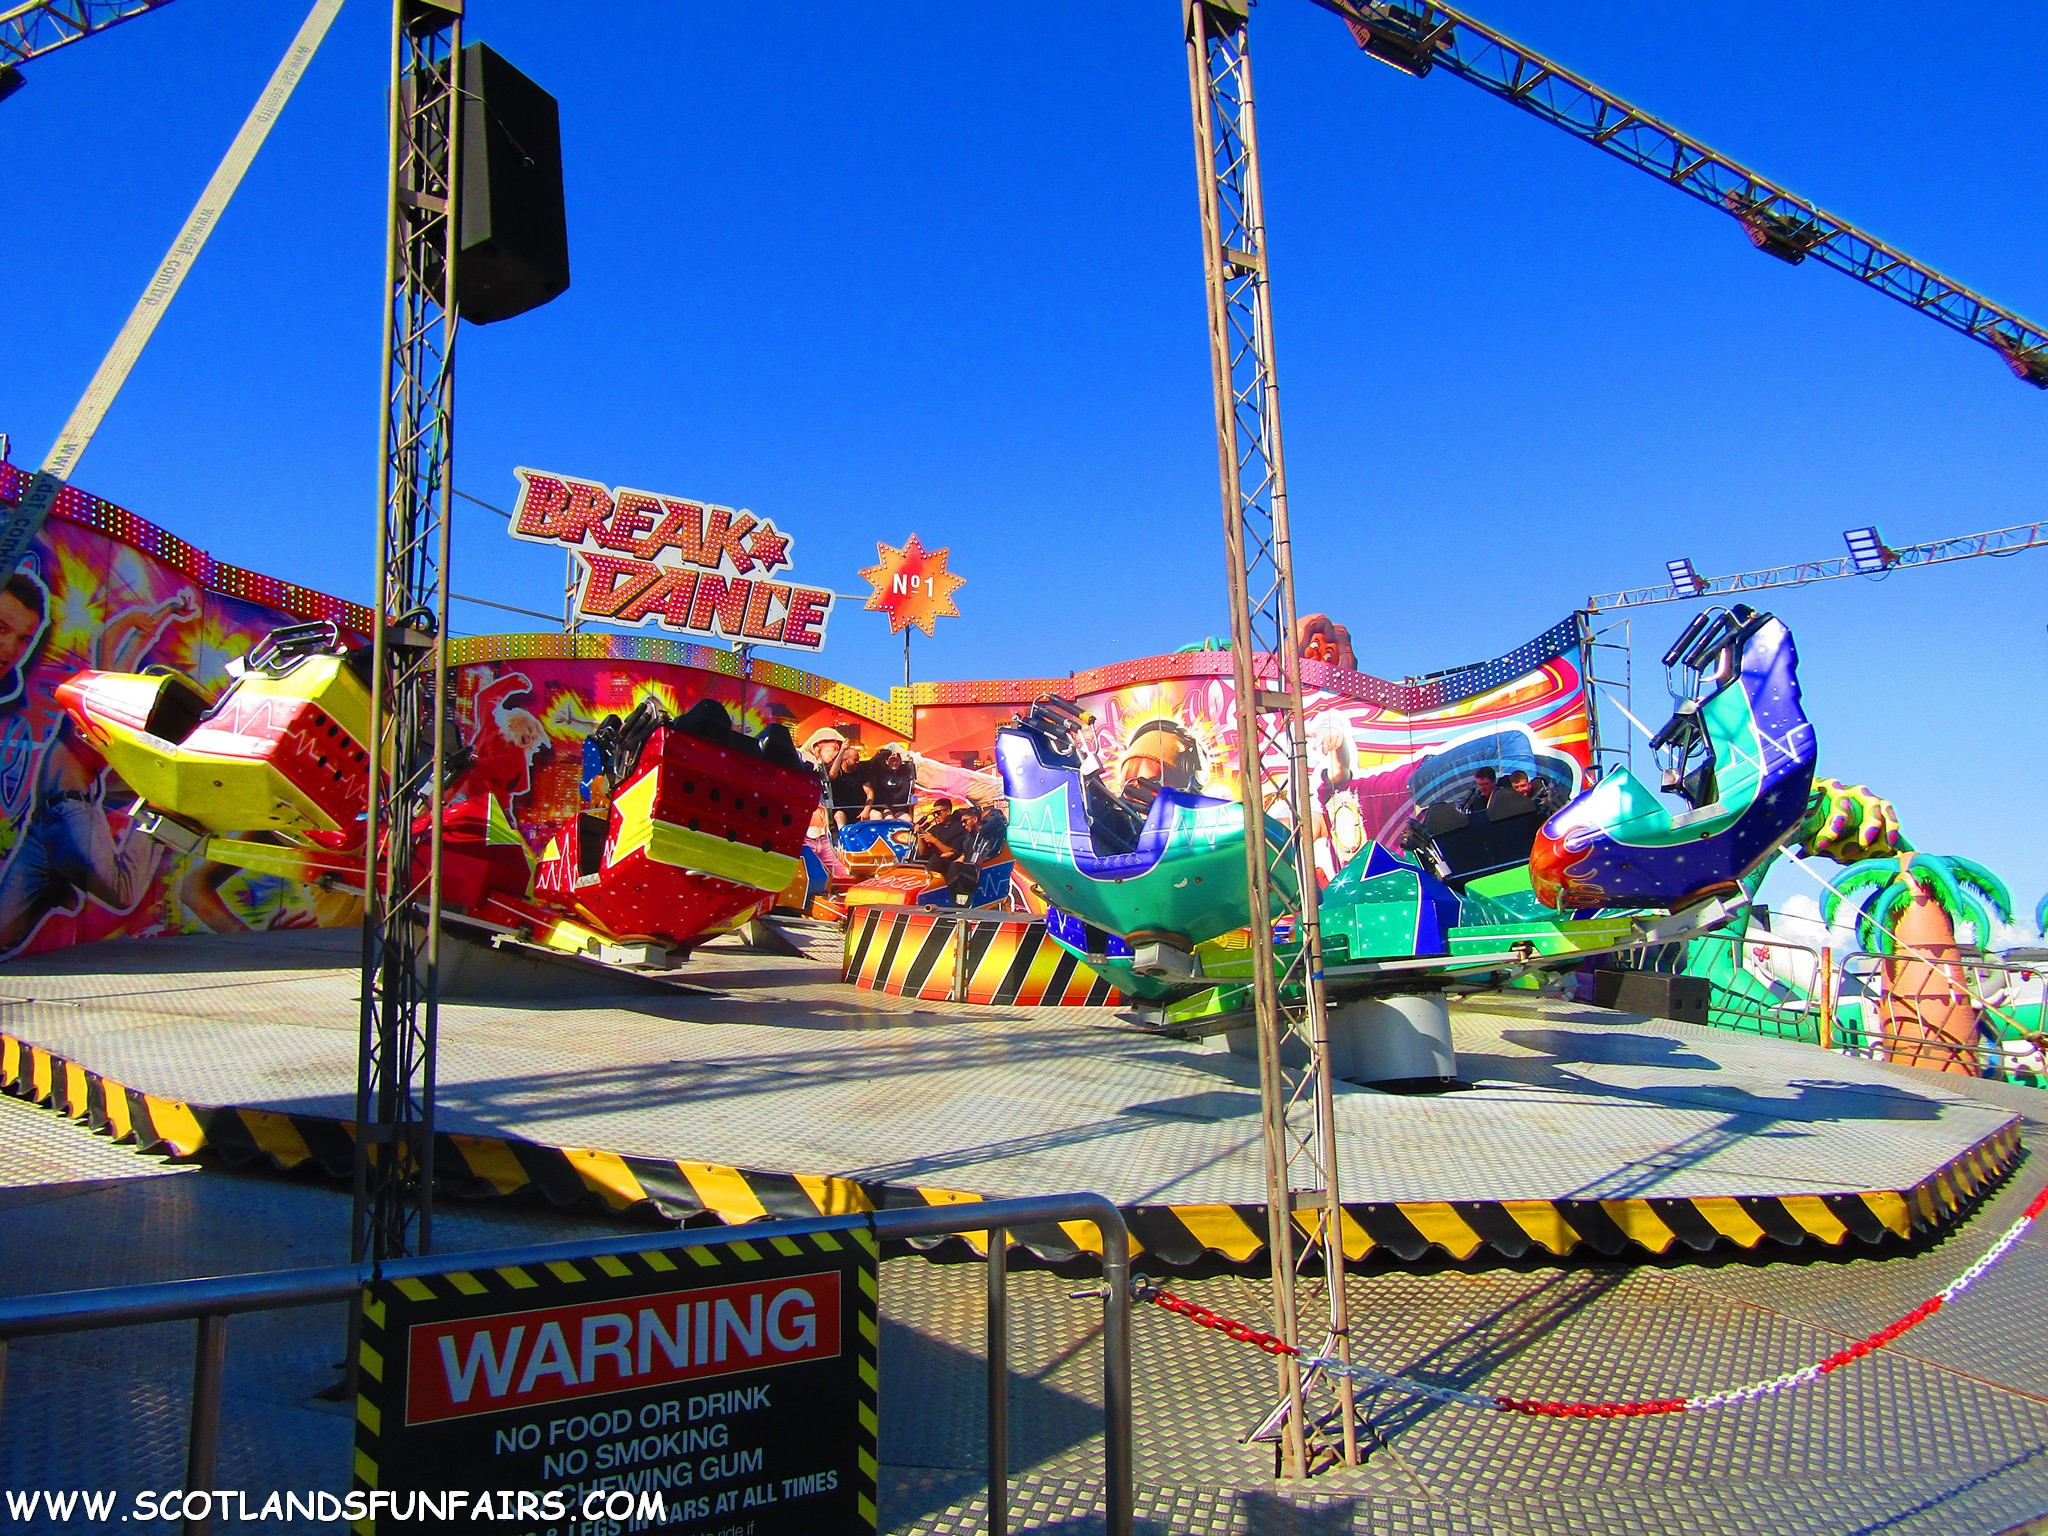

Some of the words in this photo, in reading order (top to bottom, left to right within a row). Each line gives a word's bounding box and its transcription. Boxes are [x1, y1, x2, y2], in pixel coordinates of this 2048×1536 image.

[516, 472, 758, 575] BREAK
[578, 550, 830, 645] DANCE
[437, 1287, 817, 1403] WARNING
[495, 1423, 541, 1456] NO
[548, 1408, 632, 1445] FOOD
[639, 1402, 680, 1431] OR
[688, 1384, 771, 1421] DRINK
[543, 1449, 588, 1480] NO
[595, 1423, 729, 1470] SMOKING
[553, 1461, 693, 1512] CHEWING
[700, 1448, 763, 1481] GUM
[656, 1496, 710, 1526] CARS
[714, 1489, 739, 1514] AT
[742, 1483, 778, 1509] ALL
[781, 1469, 839, 1499] TIMES
